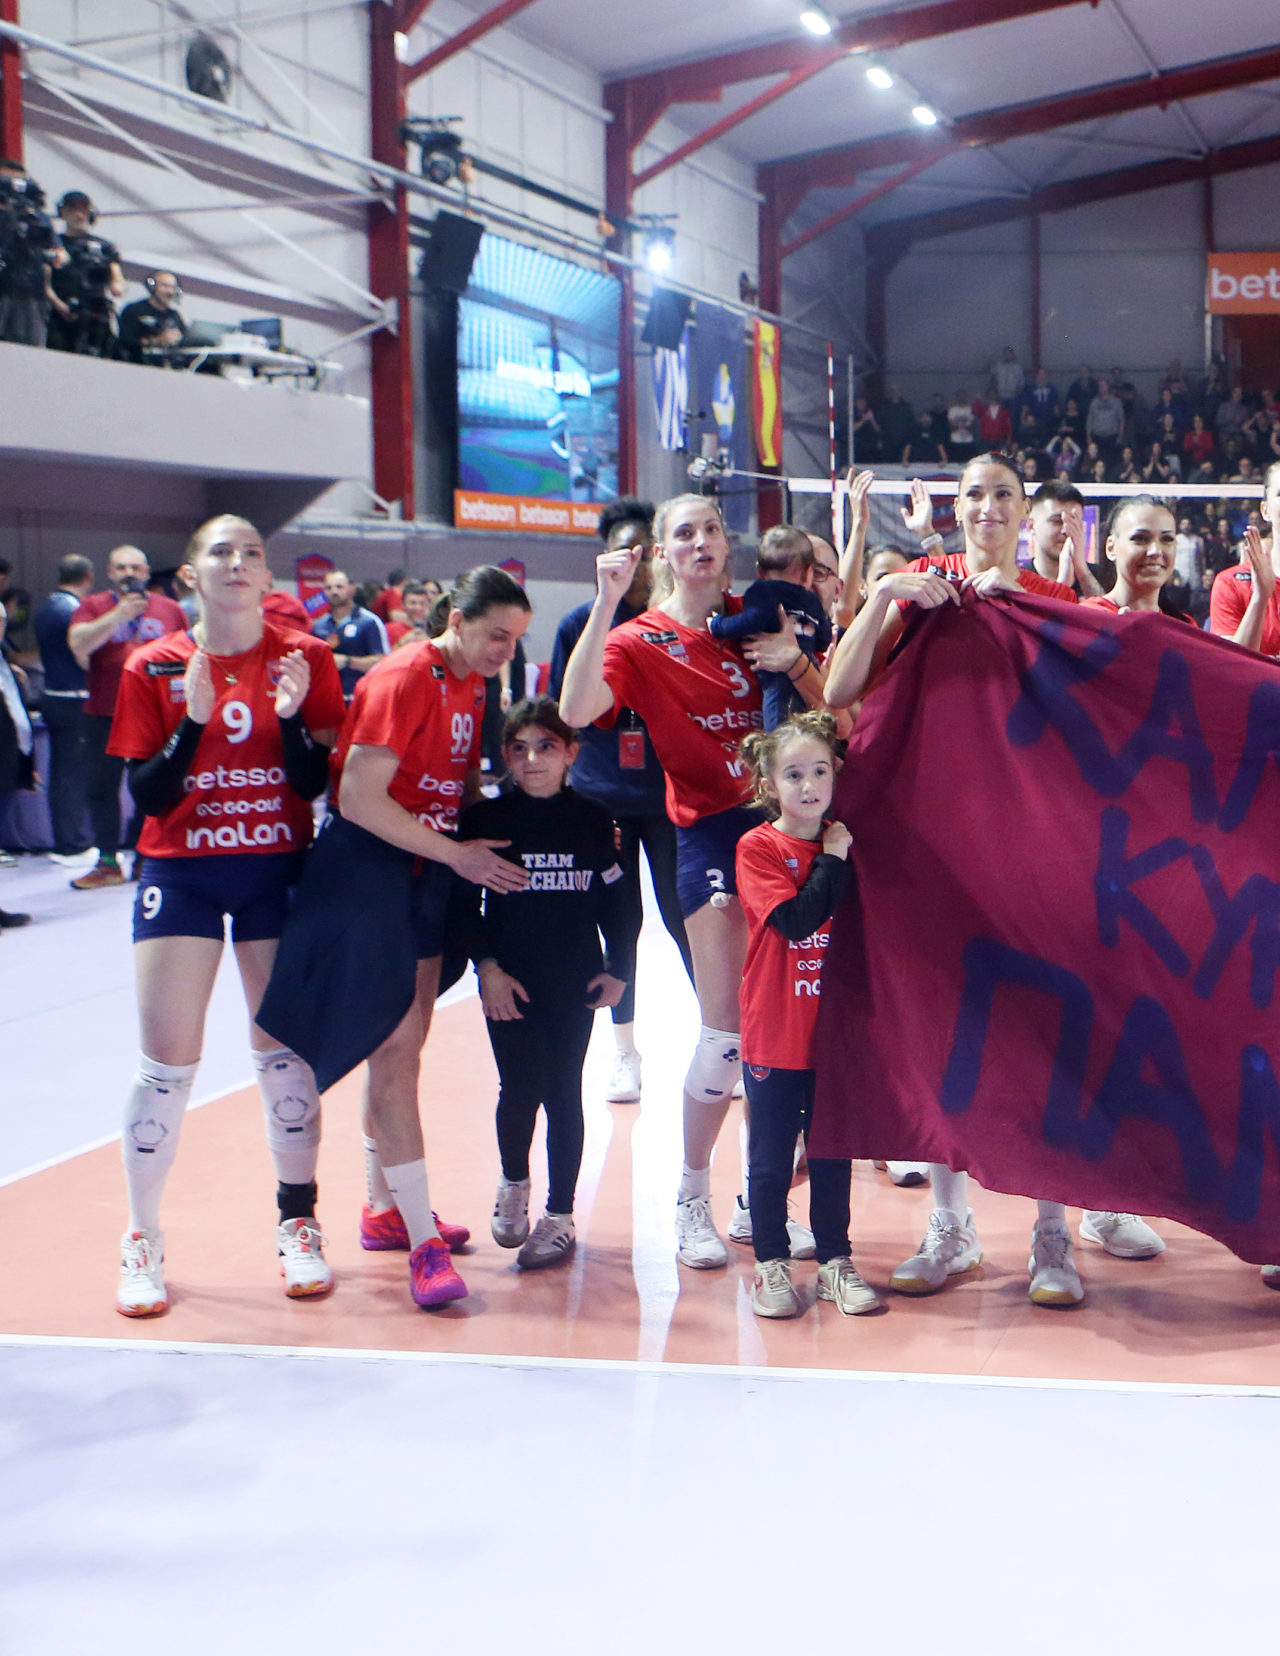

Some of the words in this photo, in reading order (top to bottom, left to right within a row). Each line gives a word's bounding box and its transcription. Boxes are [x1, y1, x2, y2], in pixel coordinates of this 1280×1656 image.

[460, 497, 516, 522] betsson
[520, 503, 570, 526] betsson
[721, 661, 749, 698] 3
[222, 701, 252, 743] 9
[450, 712, 473, 755] 99
[521, 853, 574, 869] TEAM
[523, 869, 594, 892] CHAIOU
[705, 868, 726, 890] 3
[142, 885, 163, 920] 9
